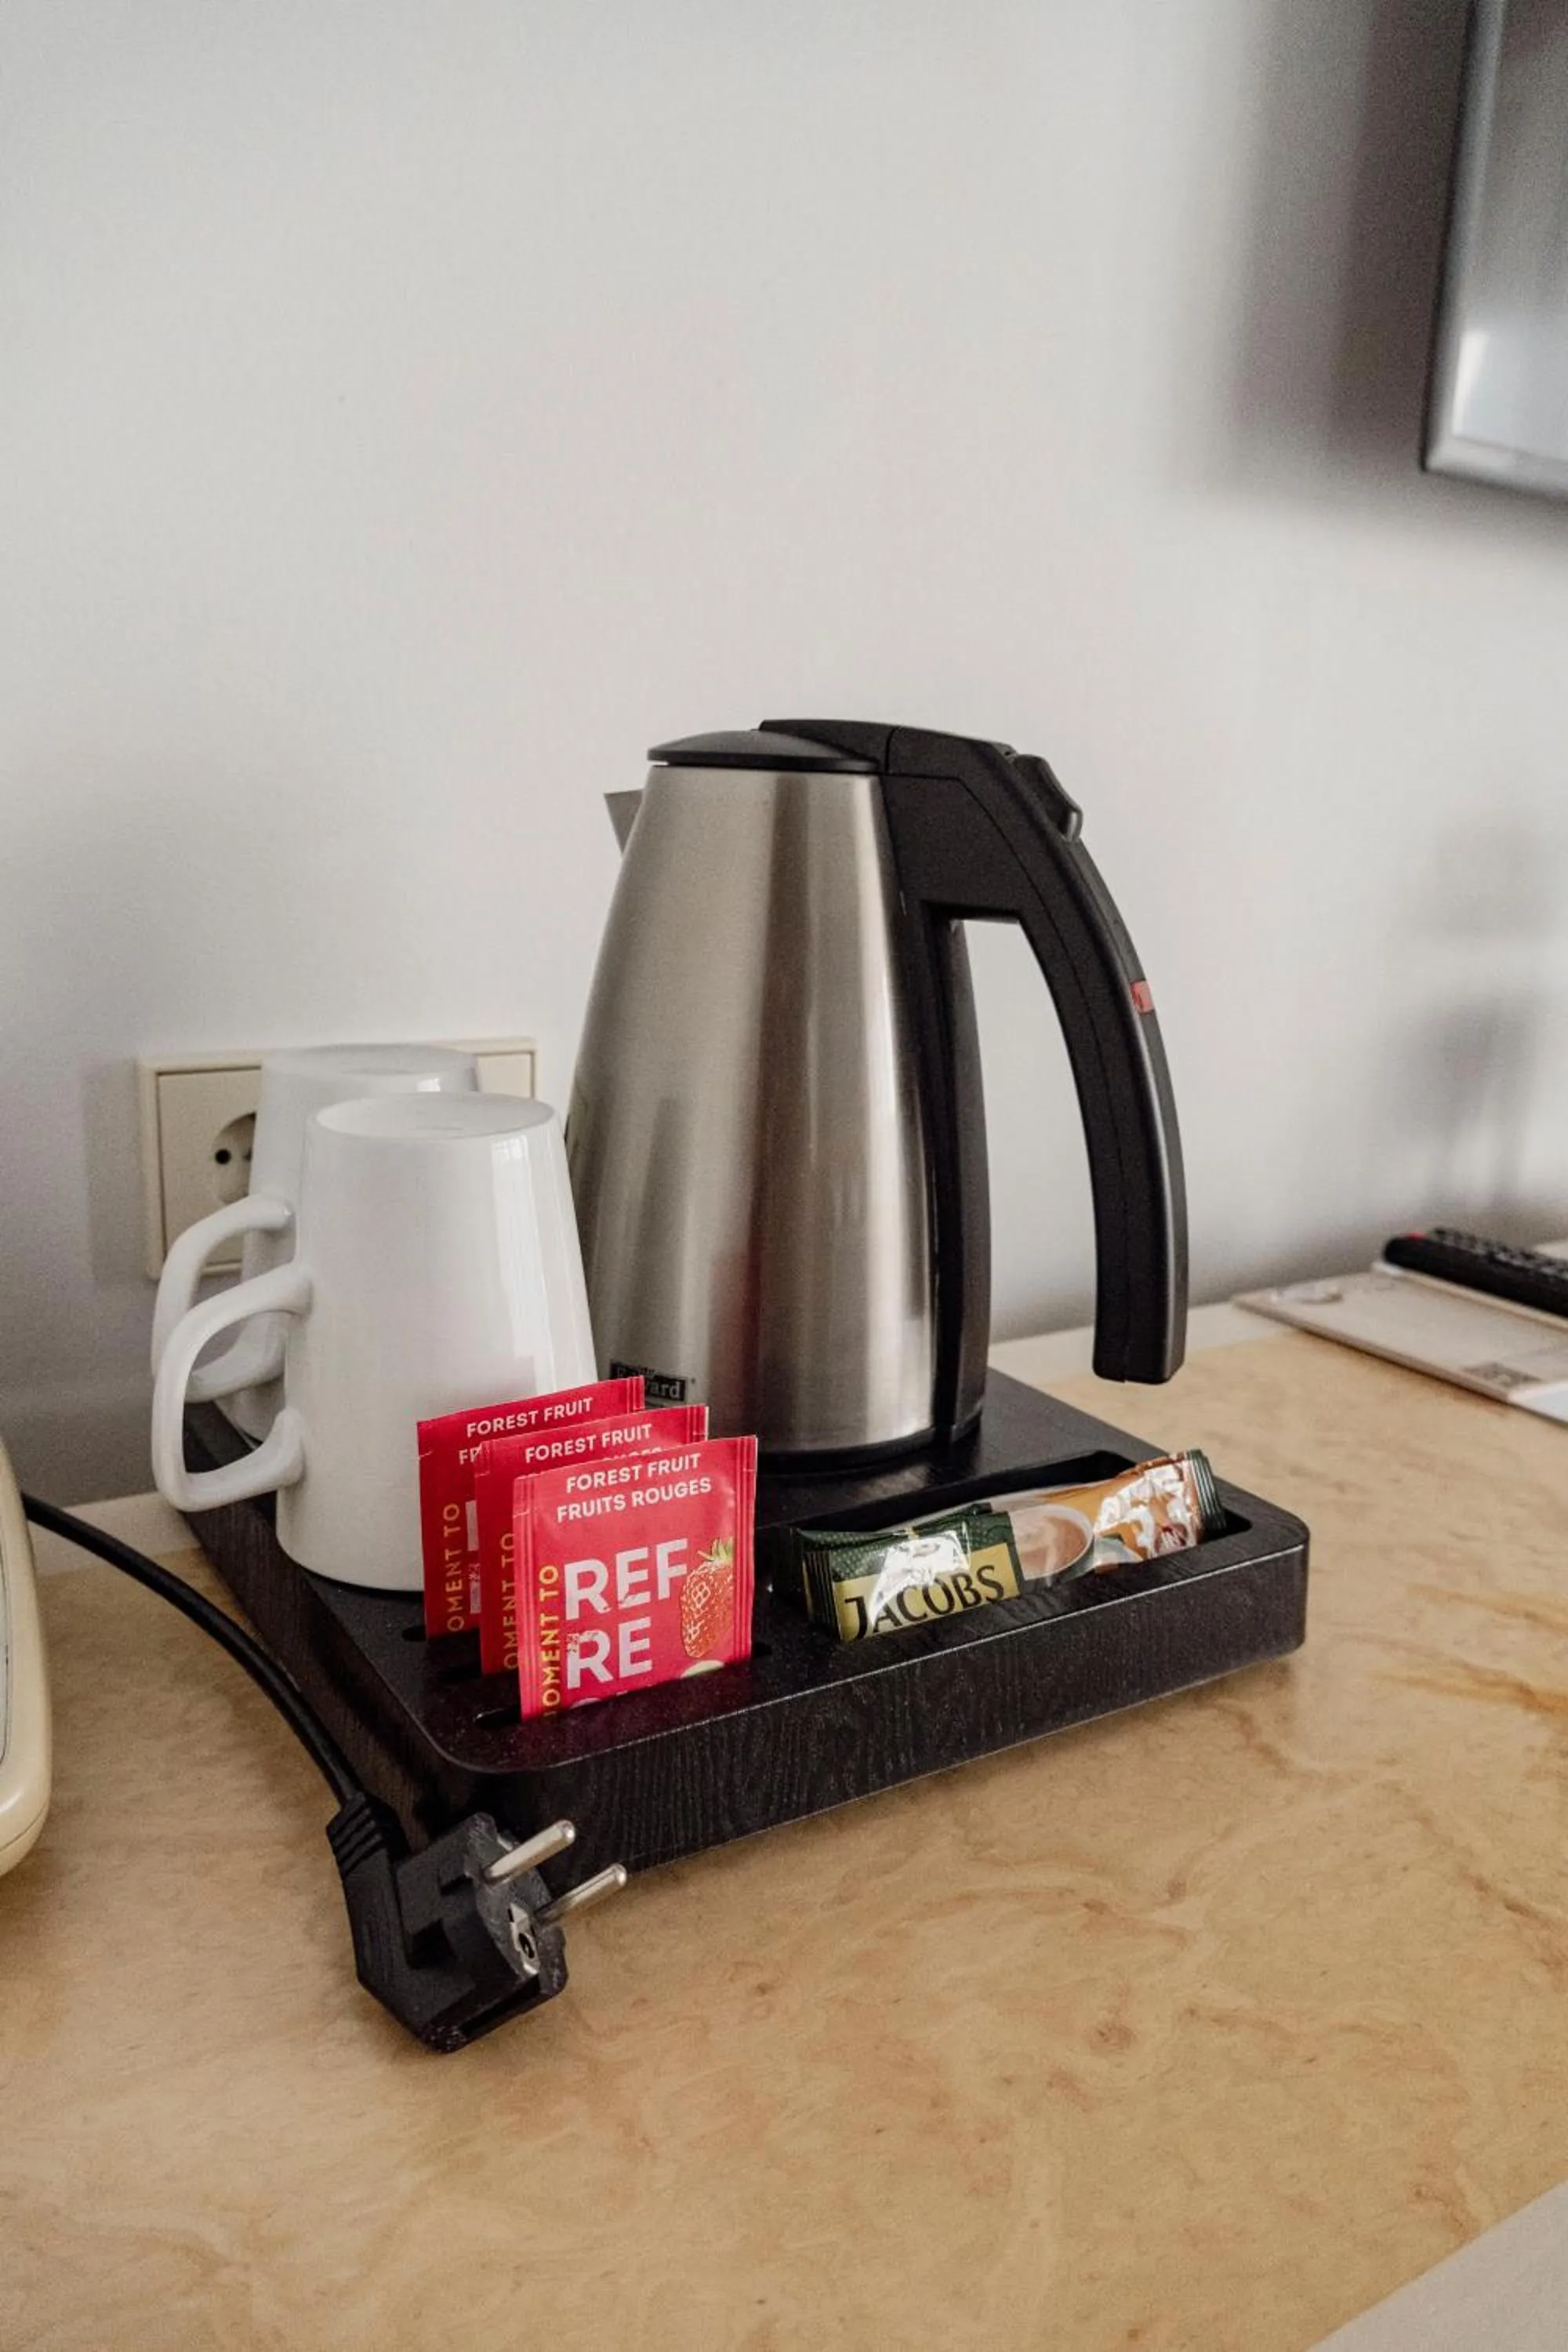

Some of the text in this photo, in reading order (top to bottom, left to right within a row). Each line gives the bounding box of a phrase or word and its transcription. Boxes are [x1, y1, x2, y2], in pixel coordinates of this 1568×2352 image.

[466, 1397, 593, 1438] FOREST FRUIT
[524, 1435, 597, 1464] FOREST
[601, 1423, 652, 1448] FRUIT
[566, 1464, 643, 1494] FOREST
[647, 1453, 701, 1478] FRUIT
[442, 1503, 461, 1538] TO
[556, 1477, 712, 1523] FRUITS ROUGES
[564, 1537, 688, 1621] REF
[844, 1564, 1004, 1640] JACOBS
[539, 1565, 561, 1716] OMENT TO
[566, 1616, 653, 1690] RE
